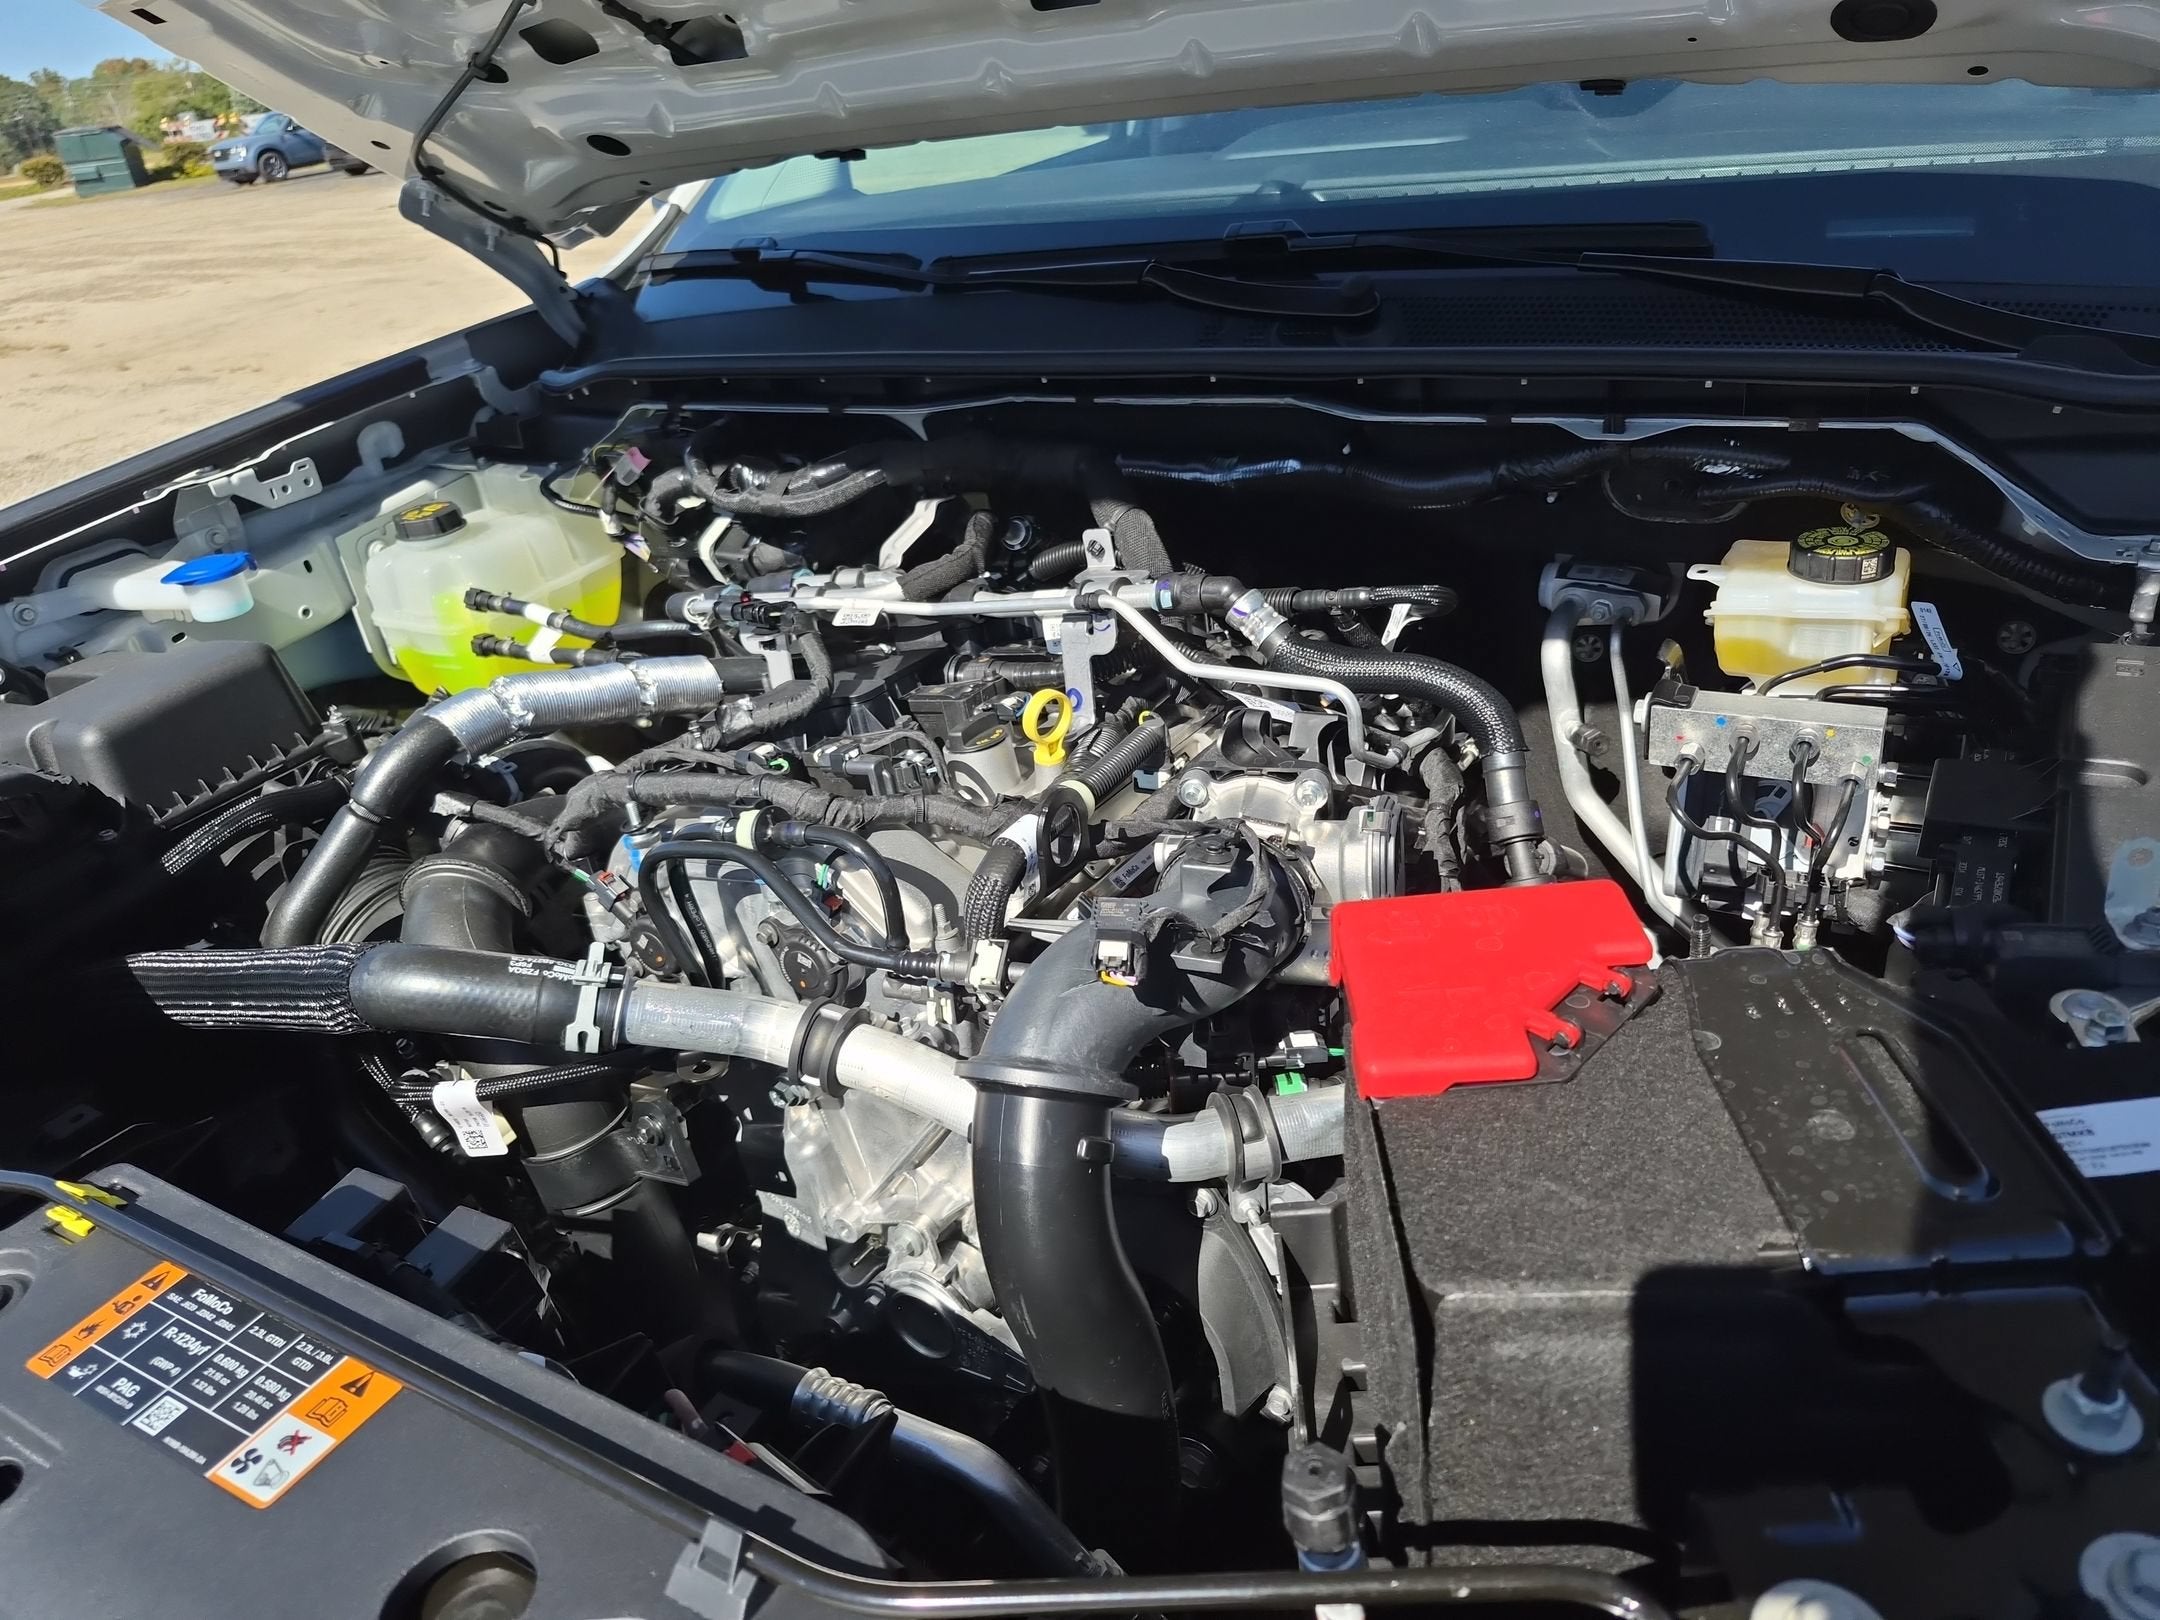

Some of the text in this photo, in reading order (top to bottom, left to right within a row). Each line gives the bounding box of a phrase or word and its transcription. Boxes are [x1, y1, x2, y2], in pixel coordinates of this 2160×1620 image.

[543, 970, 576, 981] oMoCo
[166, 1292, 184, 1304] SAE
[190, 1288, 234, 1316] FoMoCo
[162, 1326, 212, 1356] R-1234yf
[247, 1325, 287, 1349] 2.3L GTDI
[295, 1341, 315, 1356] 2.7L
[212, 1353, 250, 1380] 0.600 kg
[291, 1357, 314, 1372] GTDI
[111, 1377, 141, 1398] PAG
[275, 1387, 292, 1403] kg
